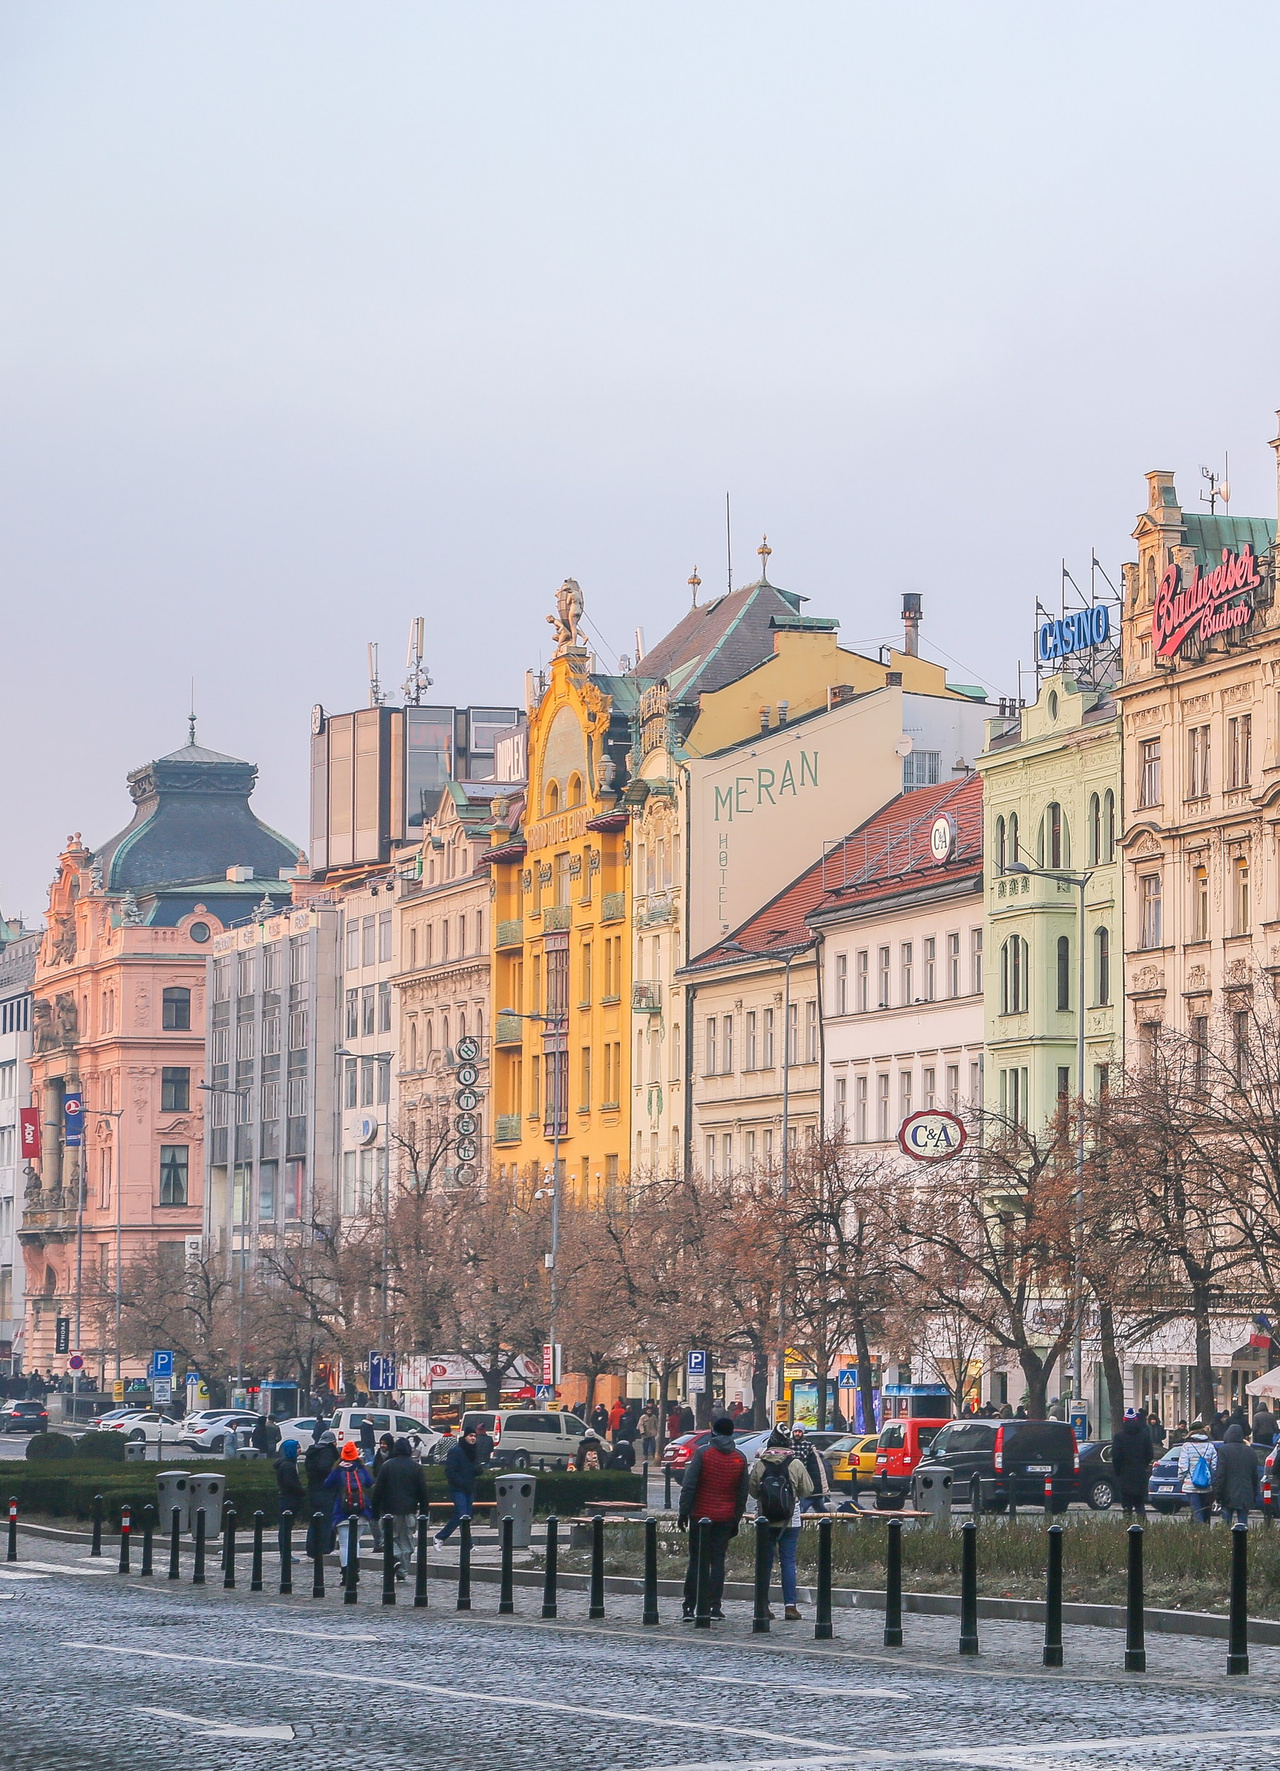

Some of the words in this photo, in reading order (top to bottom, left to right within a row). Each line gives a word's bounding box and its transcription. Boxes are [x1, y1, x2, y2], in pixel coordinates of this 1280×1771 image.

[1152, 543, 1262, 651] Budweiser
[1039, 605, 1108, 660] CASINO
[1200, 598, 1252, 641] Budvar
[497, 733, 524, 782] DUPLEX
[714, 751, 819, 821] MERAN
[934, 827, 947, 850] C&A
[719, 833, 729, 921] HOTEL
[25, 1123, 36, 1144] AON
[911, 1125, 955, 1148] C&A
[157, 1354, 168, 1370] P
[691, 1353, 702, 1368] P
